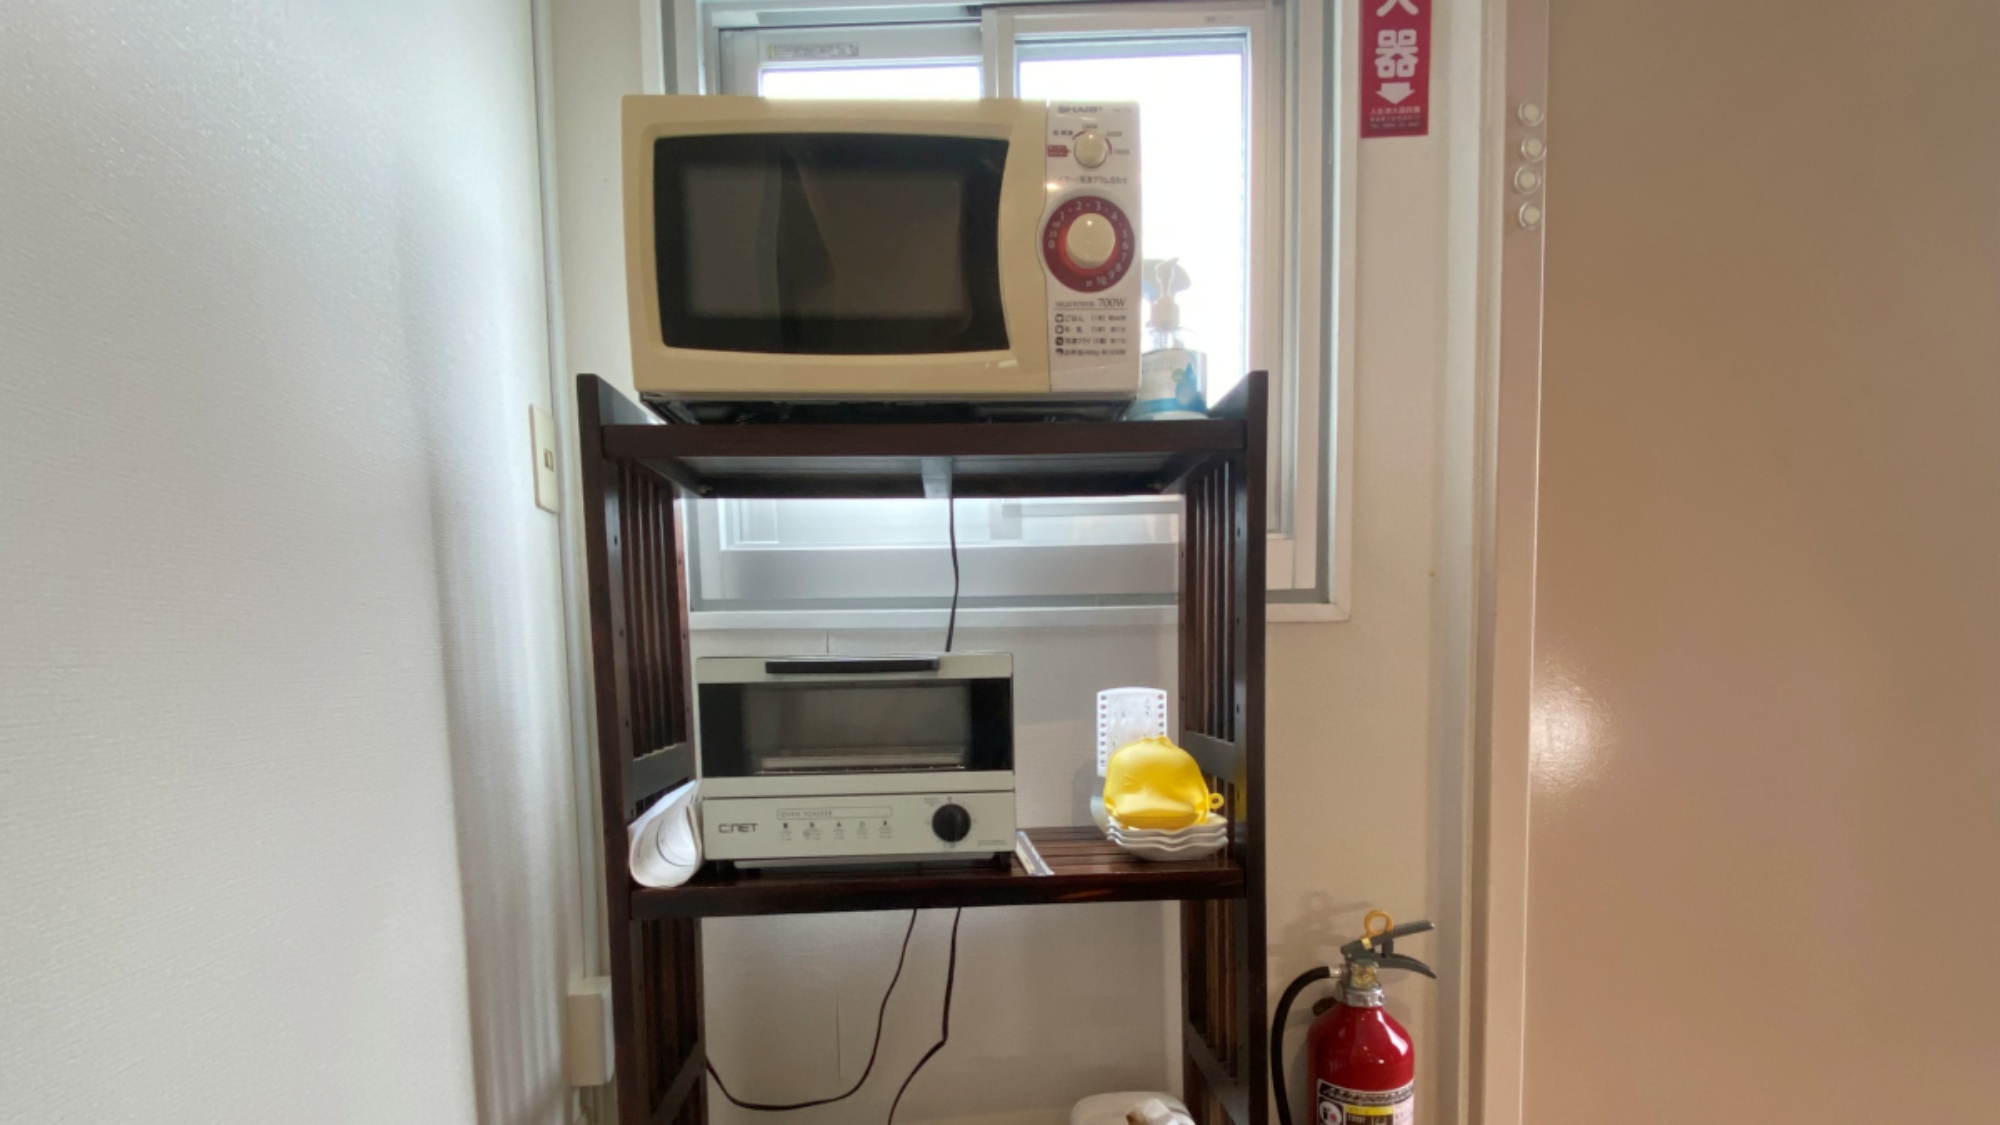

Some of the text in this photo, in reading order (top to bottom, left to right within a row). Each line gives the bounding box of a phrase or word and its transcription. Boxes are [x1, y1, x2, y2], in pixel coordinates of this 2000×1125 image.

[1076, 202, 1082, 210] 2
[1095, 202, 1101, 210] 3
[1111, 211, 1118, 220] 4
[1097, 297, 1126, 308] 700W
